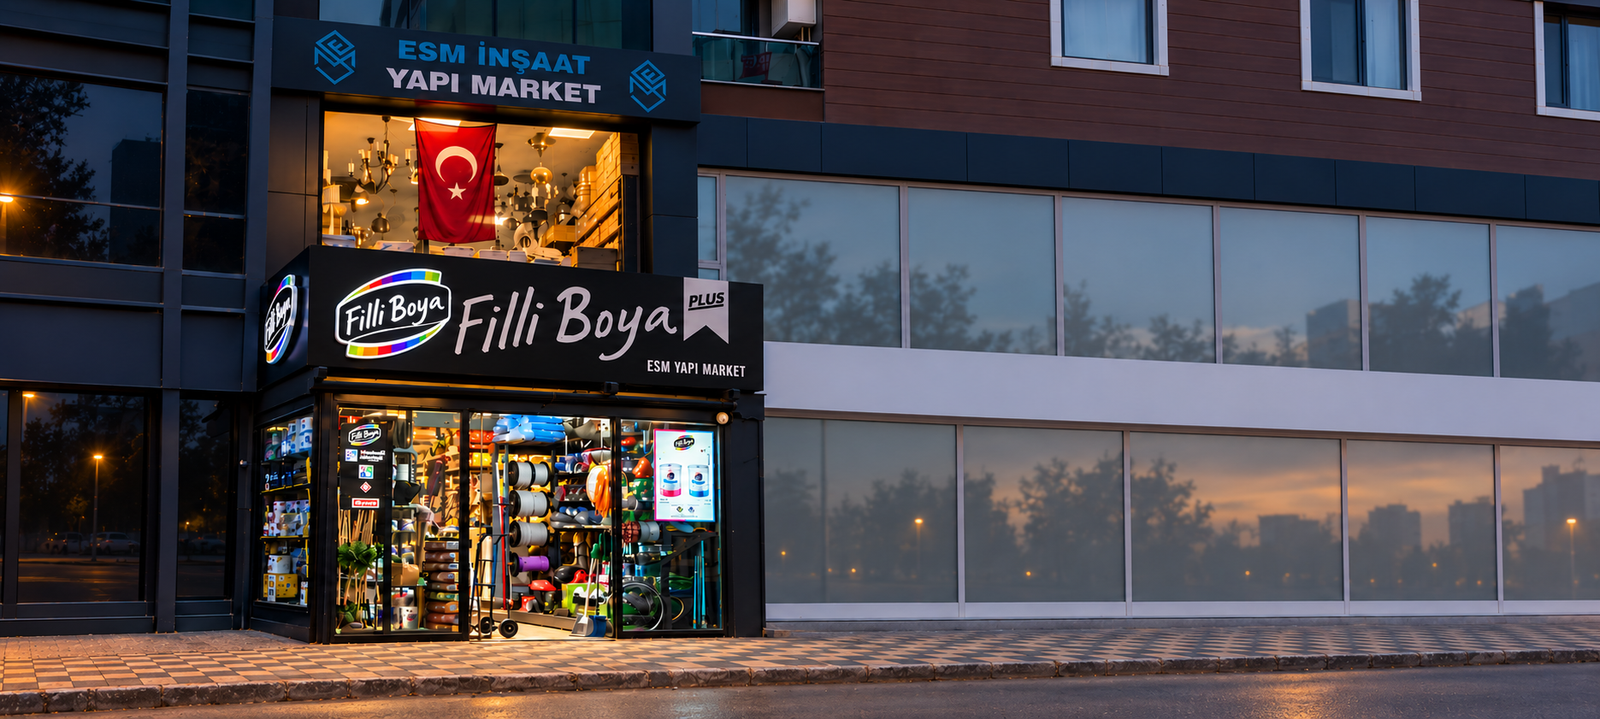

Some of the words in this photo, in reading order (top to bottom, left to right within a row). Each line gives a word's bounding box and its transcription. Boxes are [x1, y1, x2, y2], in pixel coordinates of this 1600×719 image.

[398, 39, 466, 64] ESM
[478, 40, 591, 76] İNŞAAT
[386, 67, 459, 96] YAPI
[471, 74, 604, 105] MARKET
[345, 298, 386, 336] Filli
[388, 294, 446, 327] Boya
[687, 292, 726, 309] PLUS
[455, 286, 545, 355] Filli
[556, 286, 678, 361] Boya
[647, 359, 671, 373] ESM
[674, 361, 698, 375] YAPI
[702, 363, 746, 378] MARKET
